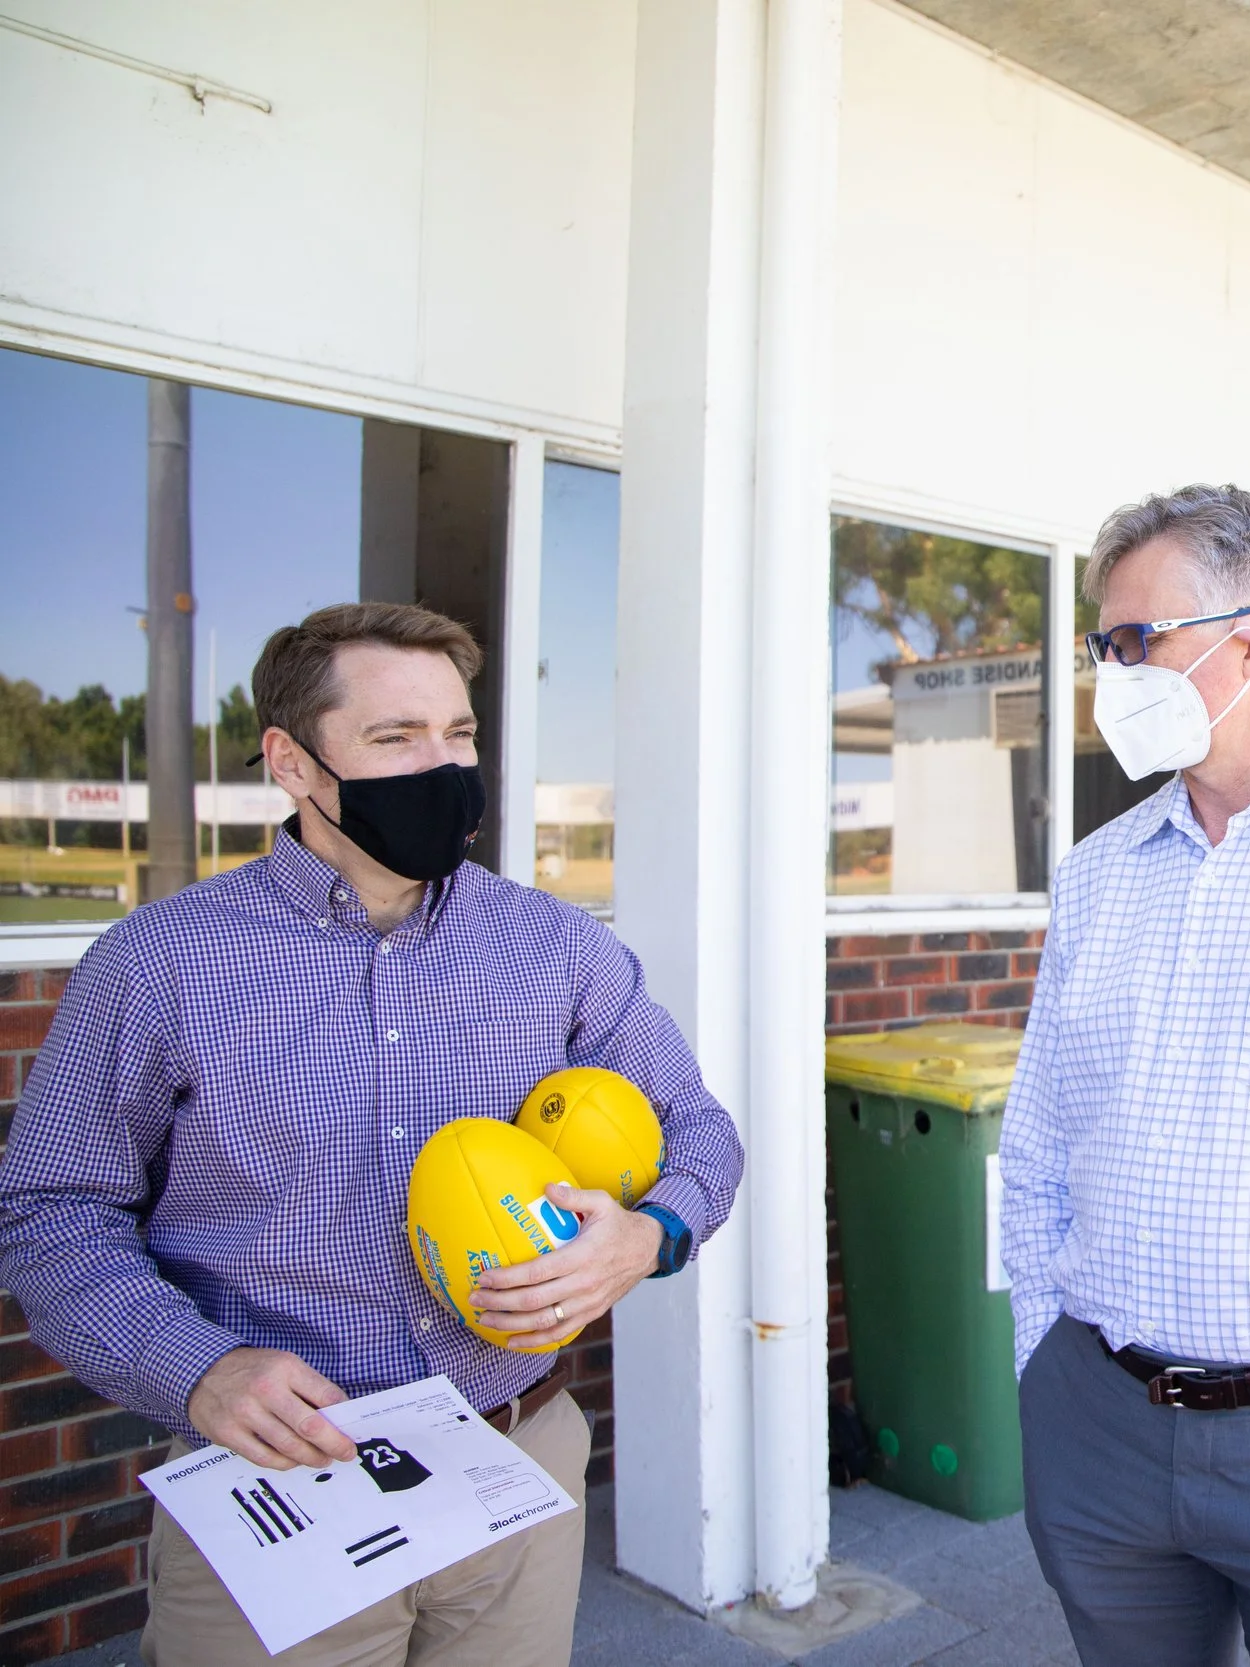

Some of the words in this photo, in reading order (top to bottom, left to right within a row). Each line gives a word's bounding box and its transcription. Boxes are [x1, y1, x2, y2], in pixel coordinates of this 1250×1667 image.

[500, 1194, 552, 1255] SULLIVAN
[166, 1452, 229, 1483] PRODUCTION
[363, 1445, 401, 1470] 23
[488, 1499, 559, 1532] Blackchrome
